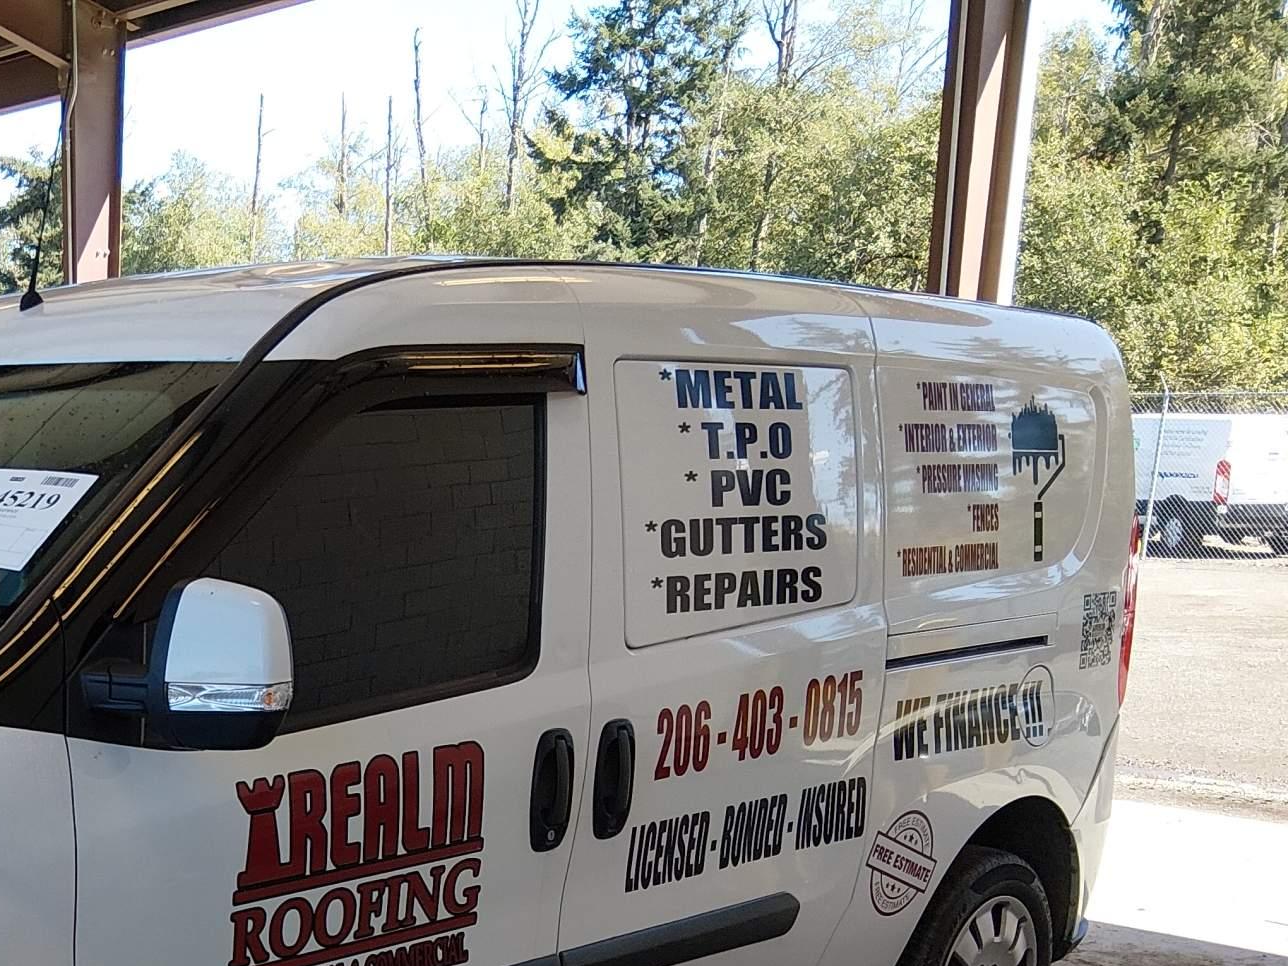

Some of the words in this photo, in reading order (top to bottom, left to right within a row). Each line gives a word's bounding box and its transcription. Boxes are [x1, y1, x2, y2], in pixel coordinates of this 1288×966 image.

[676, 369, 802, 410] METAL
[922, 382, 946, 410] PAINT
[949, 383, 958, 410] IN
[960, 384, 995, 411] GENERAL
[701, 422, 792, 460] T.P.O
[905, 424, 946, 452] INTERIOR
[949, 429, 955, 451] &
[958, 424, 998, 452] EXTERIOR
[711, 469, 791, 507] PVC
[922, 464, 962, 494] PRESSURE
[963, 464, 999, 491] WASHING
[661, 513, 827, 559] GUTTERS
[972, 504, 999, 532] FENCES
[902, 545, 946, 577] RESIDENTIAL
[948, 552, 954, 570] &
[955, 542, 999, 572] COMMERCIAL
[666, 566, 822, 614] REPAIRS
[654, 700, 711, 781] 206
[732, 686, 784, 761] 403
[803, 670, 863, 746] 0815
[894, 696, 930, 761] WE
[934, 682, 1020, 754] FINANCE
[288, 740, 484, 876] REALM
[625, 810, 710, 893] LICENSED
[719, 794, 788, 870] BONDED
[795, 776, 866, 850] INSURED
[872, 844, 893, 865] FREE
[894, 854, 931, 882] ESTIMATE
